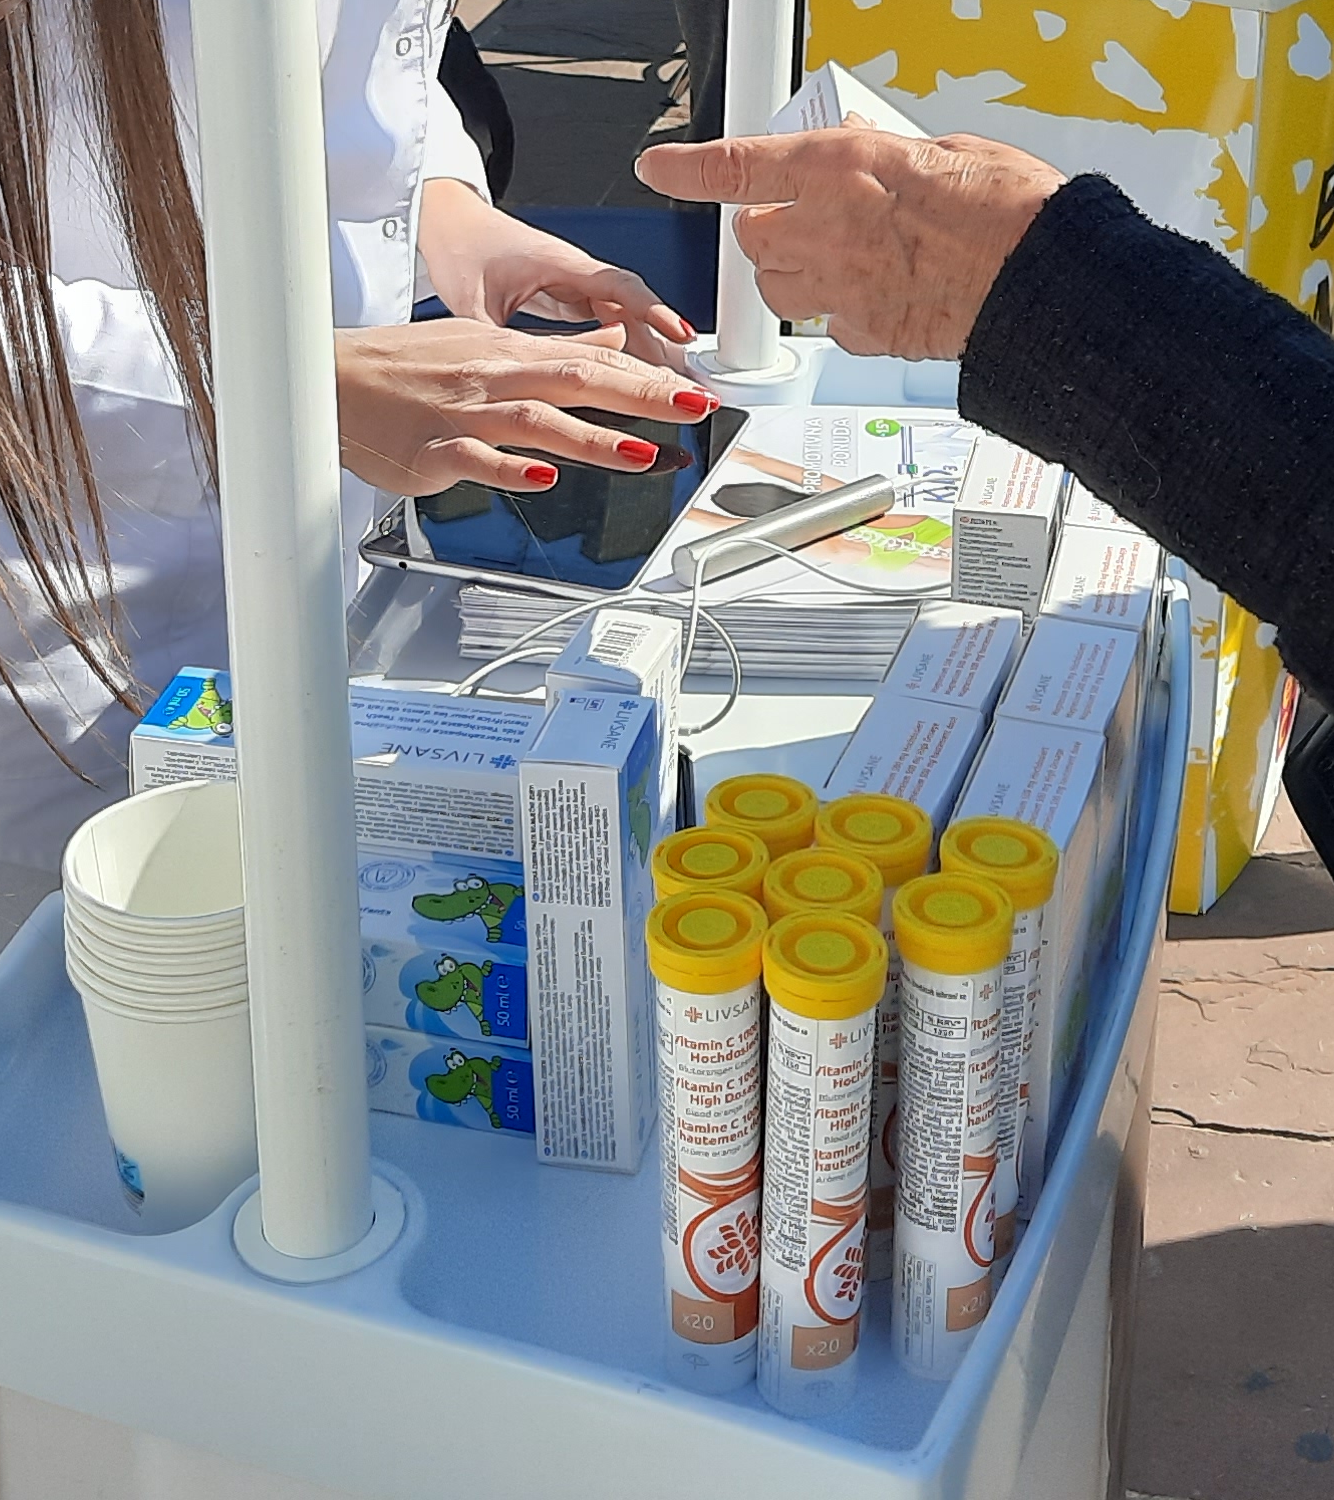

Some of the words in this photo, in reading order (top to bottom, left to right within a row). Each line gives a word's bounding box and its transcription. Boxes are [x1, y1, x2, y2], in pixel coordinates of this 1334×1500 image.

[832, 417, 852, 468] PONUDA
[803, 417, 822, 494] PROMOTIVNA
[423, 718, 440, 726] for
[450, 713, 472, 721] pour
[474, 715, 530, 728] Dentifrice
[443, 721, 499, 733] Toothpaste
[502, 727, 526, 736] Kids
[600, 709, 633, 750] LIVSANE
[433, 729, 521, 744] Kinderzahnpasta
[381, 742, 485, 765] LIVSANE
[497, 992, 510, 1009] ml
[497, 1011, 510, 1027] 50
[726, 1037, 735, 1048] C
[727, 1078, 735, 1090] C
[507, 1087, 520, 1103] ml
[690, 1094, 721, 1108] High
[507, 1105, 520, 1119] 50
[677, 1117, 728, 1134] itamine
[730, 1118, 739, 1129] C
[830, 1115, 858, 1132] High
[679, 1126, 749, 1146] hautement
[682, 1313, 715, 1331] x20
[805, 1338, 840, 1356] x20
